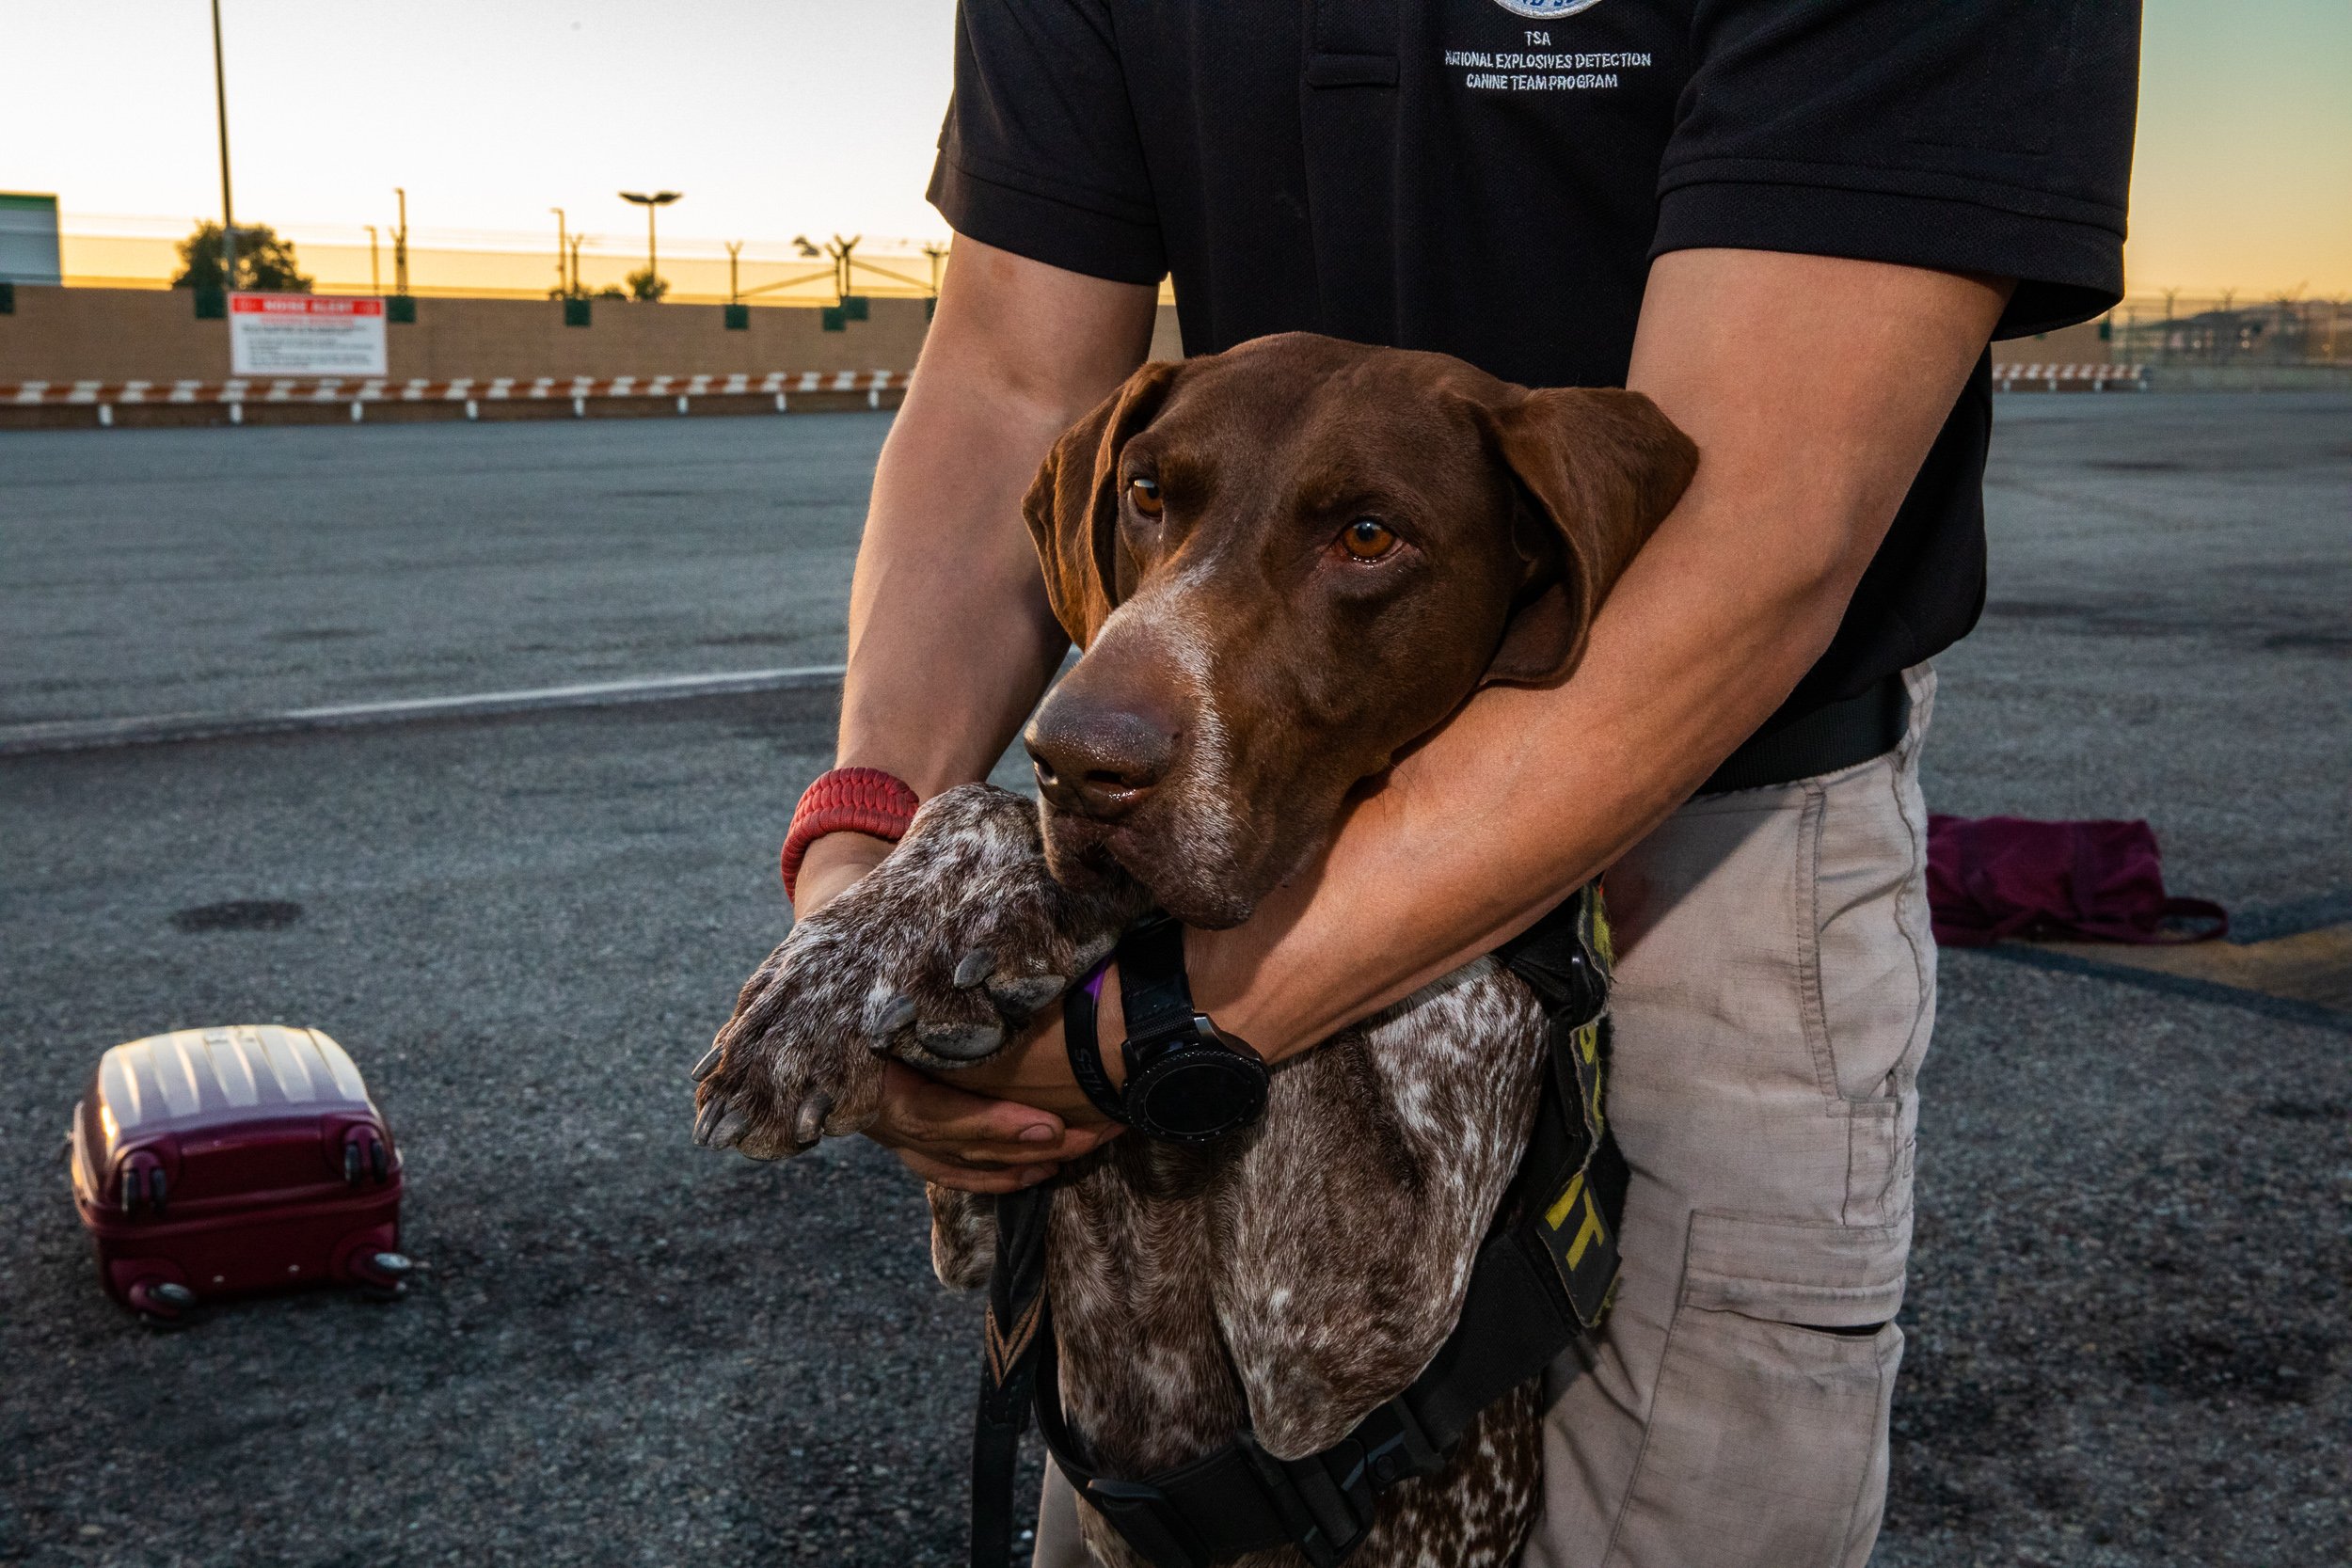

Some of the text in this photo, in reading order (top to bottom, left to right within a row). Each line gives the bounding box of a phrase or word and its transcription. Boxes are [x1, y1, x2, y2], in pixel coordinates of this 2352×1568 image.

[1524, 31, 1550, 46] TSA
[1445, 50, 1651, 69] NATIONAL EXPLOSIVES DETECTION
[1467, 73, 1618, 90] CANINE TEAM PROGRAM
